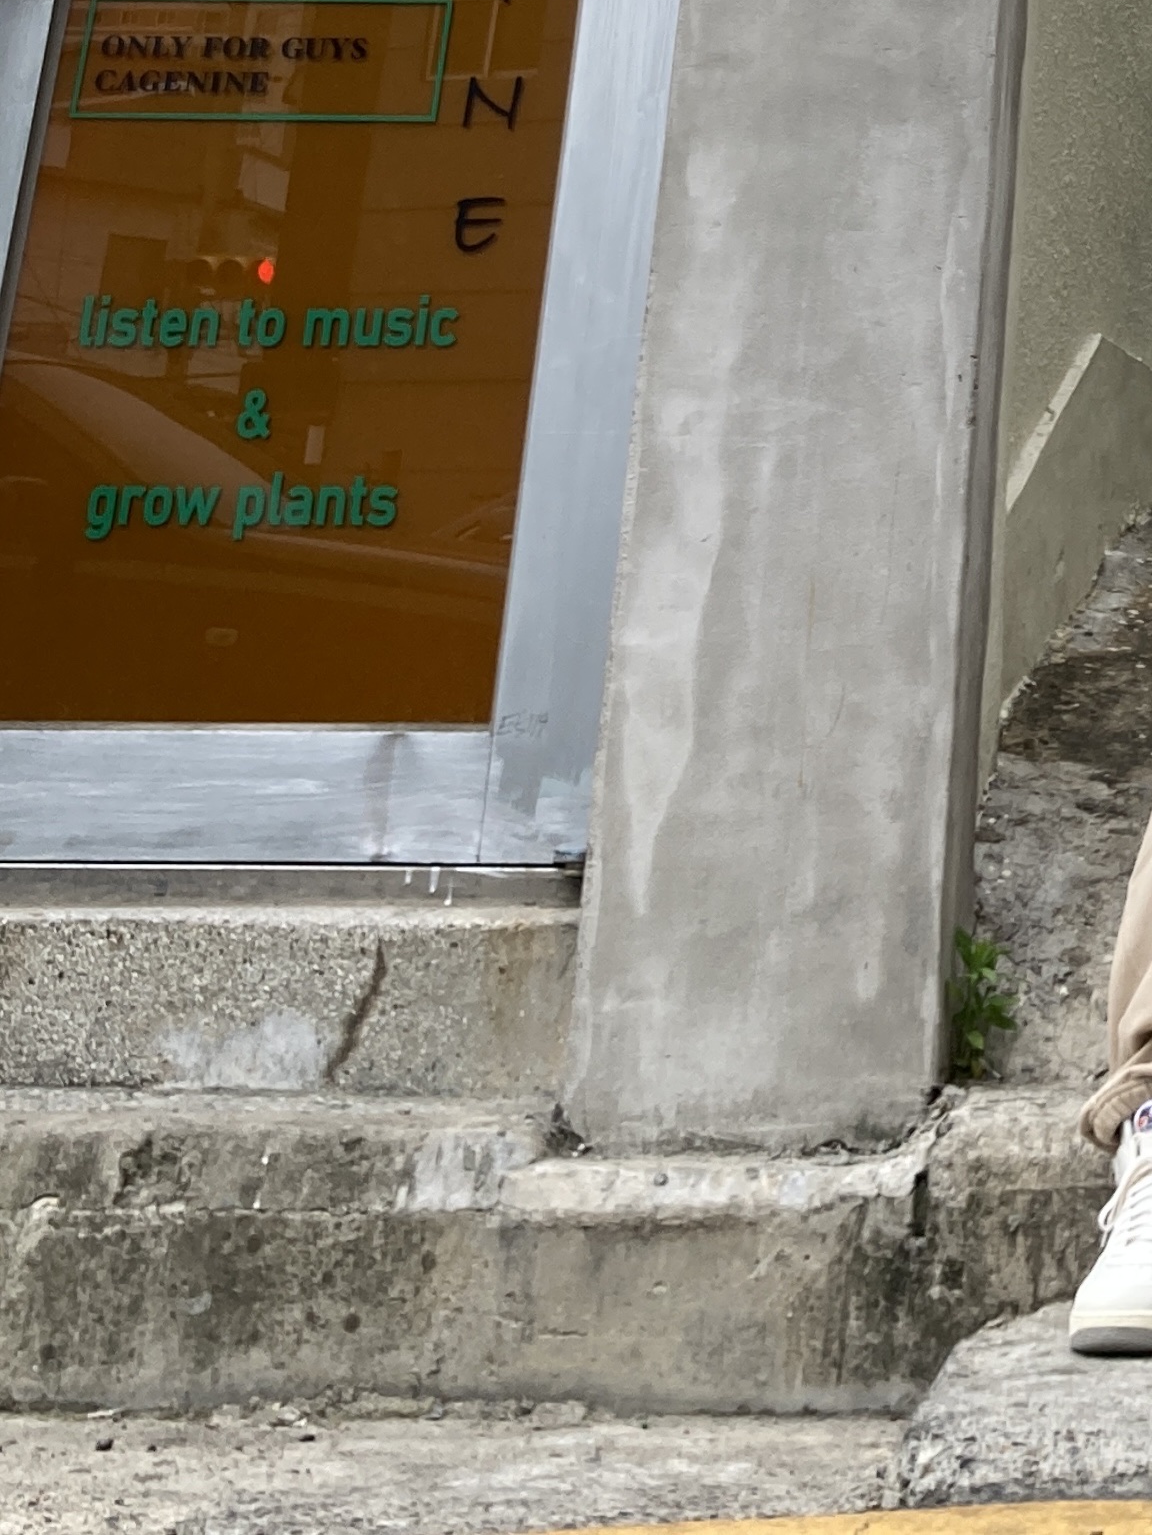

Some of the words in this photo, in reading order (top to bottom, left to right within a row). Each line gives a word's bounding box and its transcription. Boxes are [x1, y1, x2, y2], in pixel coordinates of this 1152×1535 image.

[101, 35, 192, 60] ONLY
[202, 36, 271, 60] FOR
[280, 37, 368, 61] GUYS
[95, 69, 269, 96] CAGENINE
[78, 295, 222, 348] listen
[237, 298, 287, 348] to
[302, 294, 459, 348] music
[236, 388, 271, 439] &
[84, 484, 222, 541] grow
[232, 470, 400, 542] plants
